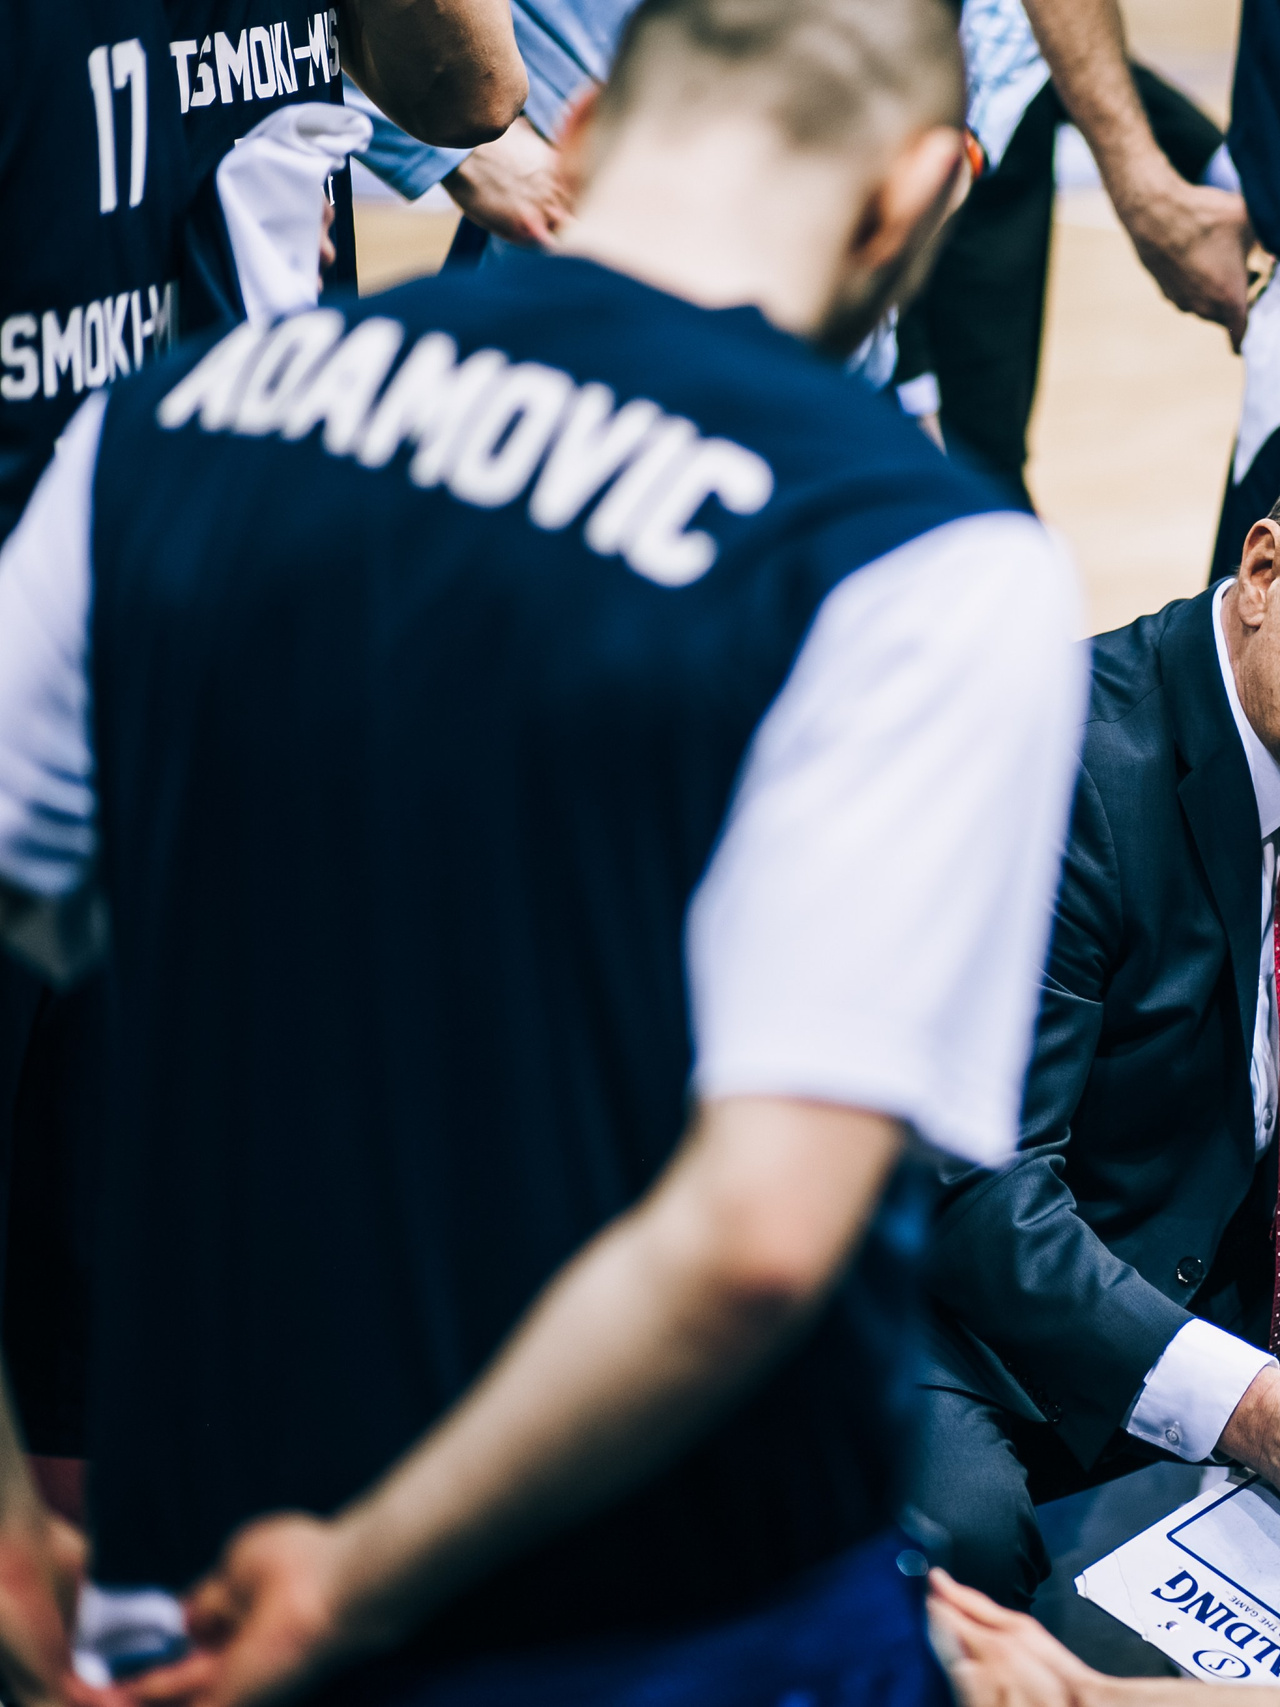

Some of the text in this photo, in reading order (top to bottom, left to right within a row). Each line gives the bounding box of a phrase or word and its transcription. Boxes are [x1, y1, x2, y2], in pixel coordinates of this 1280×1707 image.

[87, 39, 148, 214] 17
[157, 306, 774, 588] ADAMOVIC
[1228, 1595, 1259, 1618] GAME
[1258, 1616, 1278, 1632] THE
